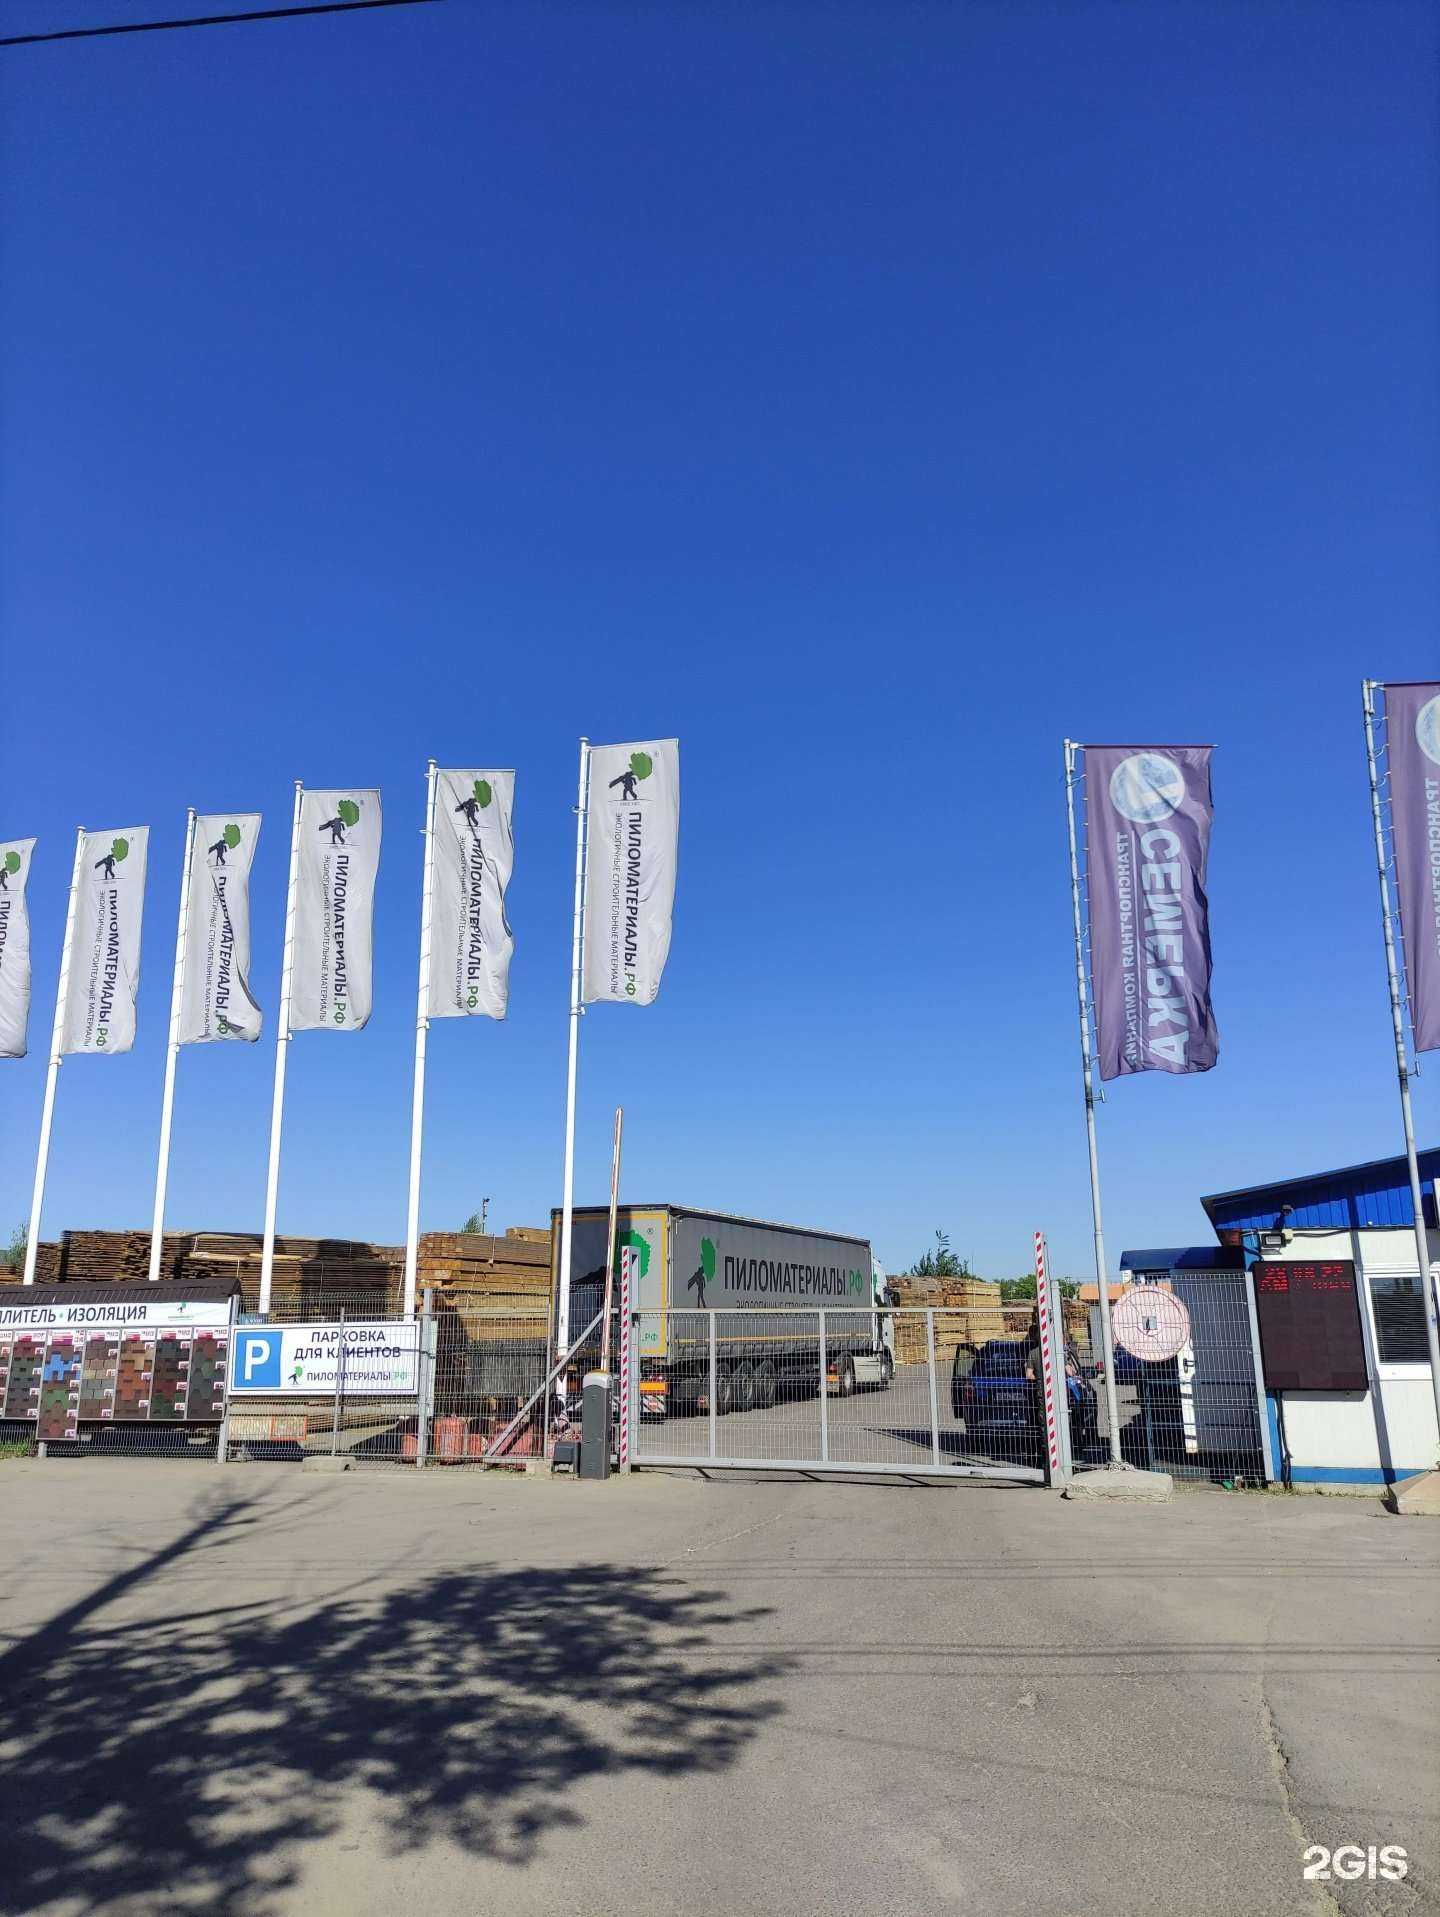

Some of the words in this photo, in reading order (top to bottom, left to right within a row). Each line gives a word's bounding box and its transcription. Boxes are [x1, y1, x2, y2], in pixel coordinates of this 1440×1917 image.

[613, 812, 623, 872] ЭКОЛОГИЧНЫЕ
[95, 890, 106, 944] ЭКОЛОГИЧНЫЕ
[466, 838, 482, 1008] ПИЛОМАТЕРИАЛЫ.РФ
[611, 873, 620, 938] СТРОИТЕЛЬНЫЕ
[624, 811, 642, 996] ПИЛОМАТЕРИАЛЫ.РФ
[206, 929, 217, 987] СТРОИТЕЛЬНЫЕ
[333, 854, 350, 1024] ПИЛОМАТЕРИАЛЫ.РФ
[88, 945, 101, 1001] СТРОИТЕЛЬНЫЕ
[96, 889, 119, 1047] ПИЛОМАТЕРИАЛЫ.РФ
[610, 941, 619, 994] МАТЕРИАЛЫ
[319, 973, 328, 1022] МАТЕРИАЛЫ
[724, 1255, 864, 1296] ПИЛОМАТЕРИАЛЫ.РФ
[0, 1308, 56, 1324] ЛИТЕЛЬ
[67, 1305, 147, 1323] ИЗОЛЯЦИЯ
[311, 1330, 386, 1343] ПАРКОВКА
[294, 1347, 322, 1361] ДЛЯ
[327, 1347, 401, 1359] КЛИЕНТОВ
